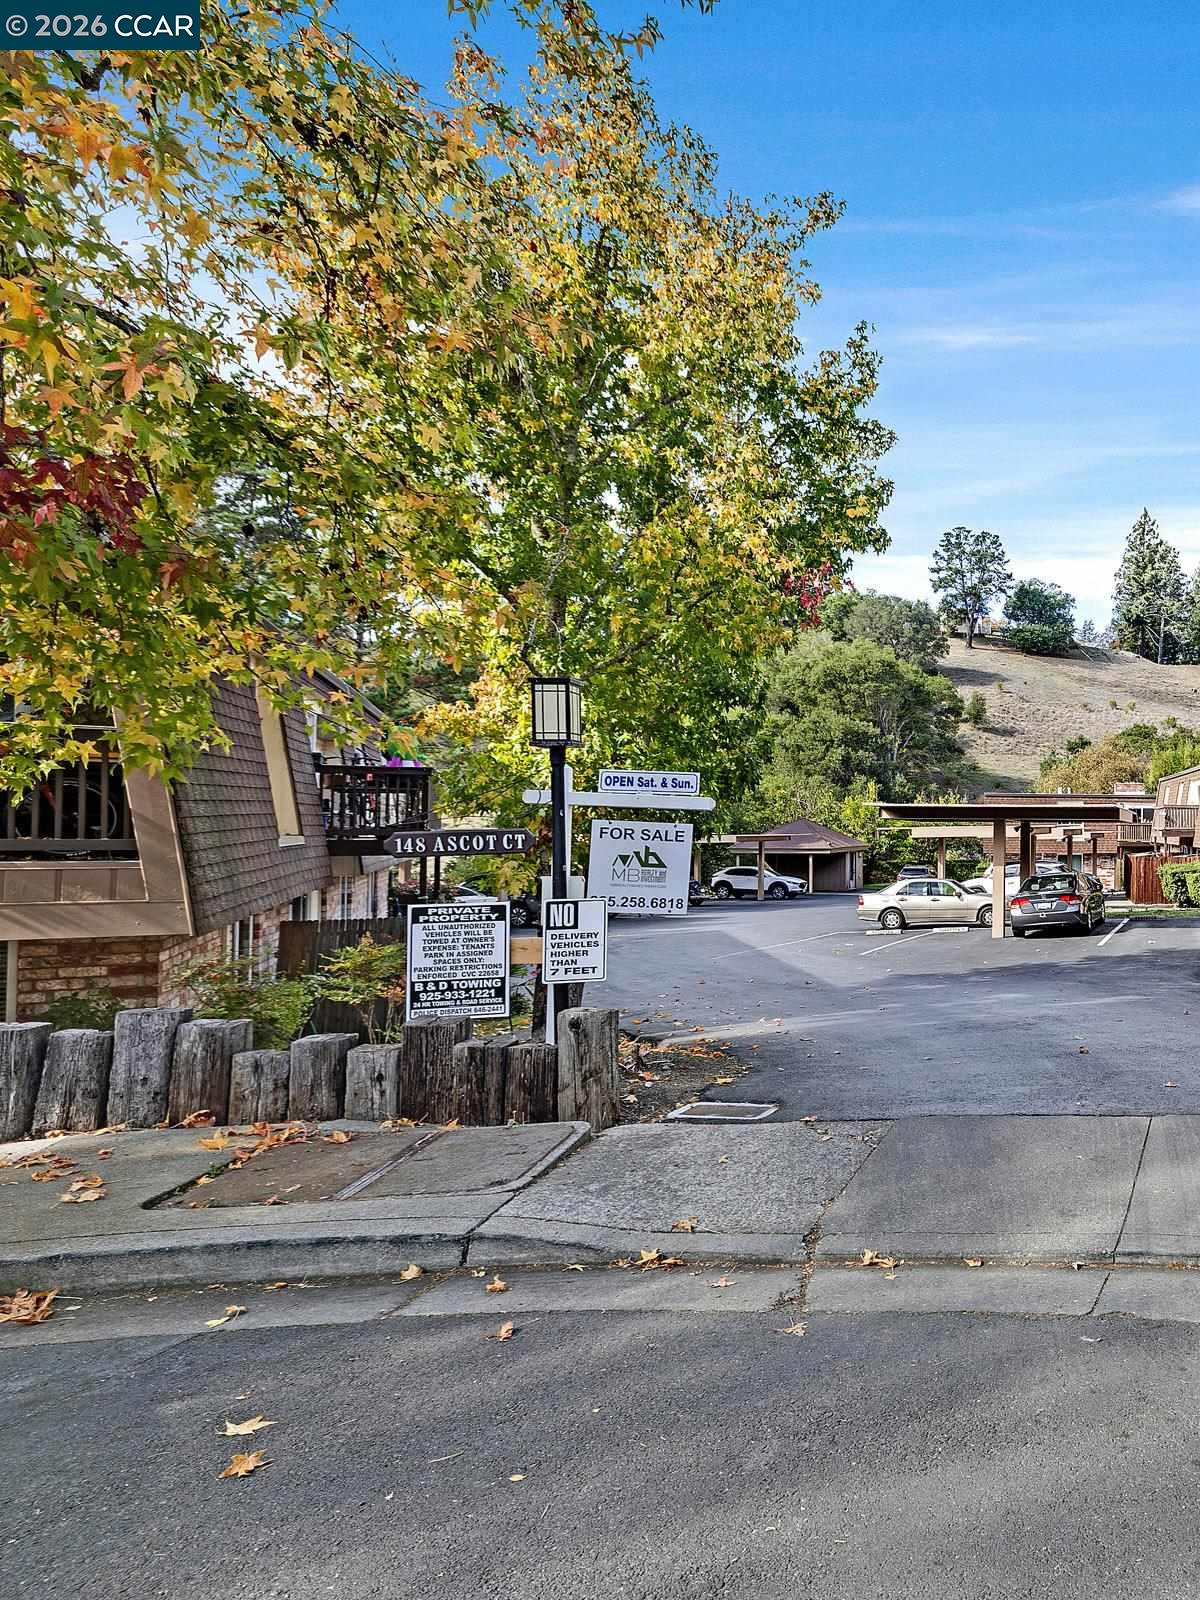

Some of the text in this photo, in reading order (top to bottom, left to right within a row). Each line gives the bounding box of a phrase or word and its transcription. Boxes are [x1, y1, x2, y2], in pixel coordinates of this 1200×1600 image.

[605, 776, 693, 789] OPEN Sat. & Sun.
[600, 827, 685, 842] FOR SALE
[394, 834, 525, 853] 148 ASCOT CT
[612, 868, 640, 882] MB
[591, 896, 683, 909] 5.258.6818
[419, 913, 498, 922] PROPERTY
[550, 904, 574, 927] NO
[551, 932, 599, 940] DELIVERY
[565, 967, 598, 975] FEET
[415, 983, 424, 991] B
[427, 982, 436, 990] &
[451, 979, 501, 989] TOWING
[420, 989, 495, 1000] 925-933-1221
